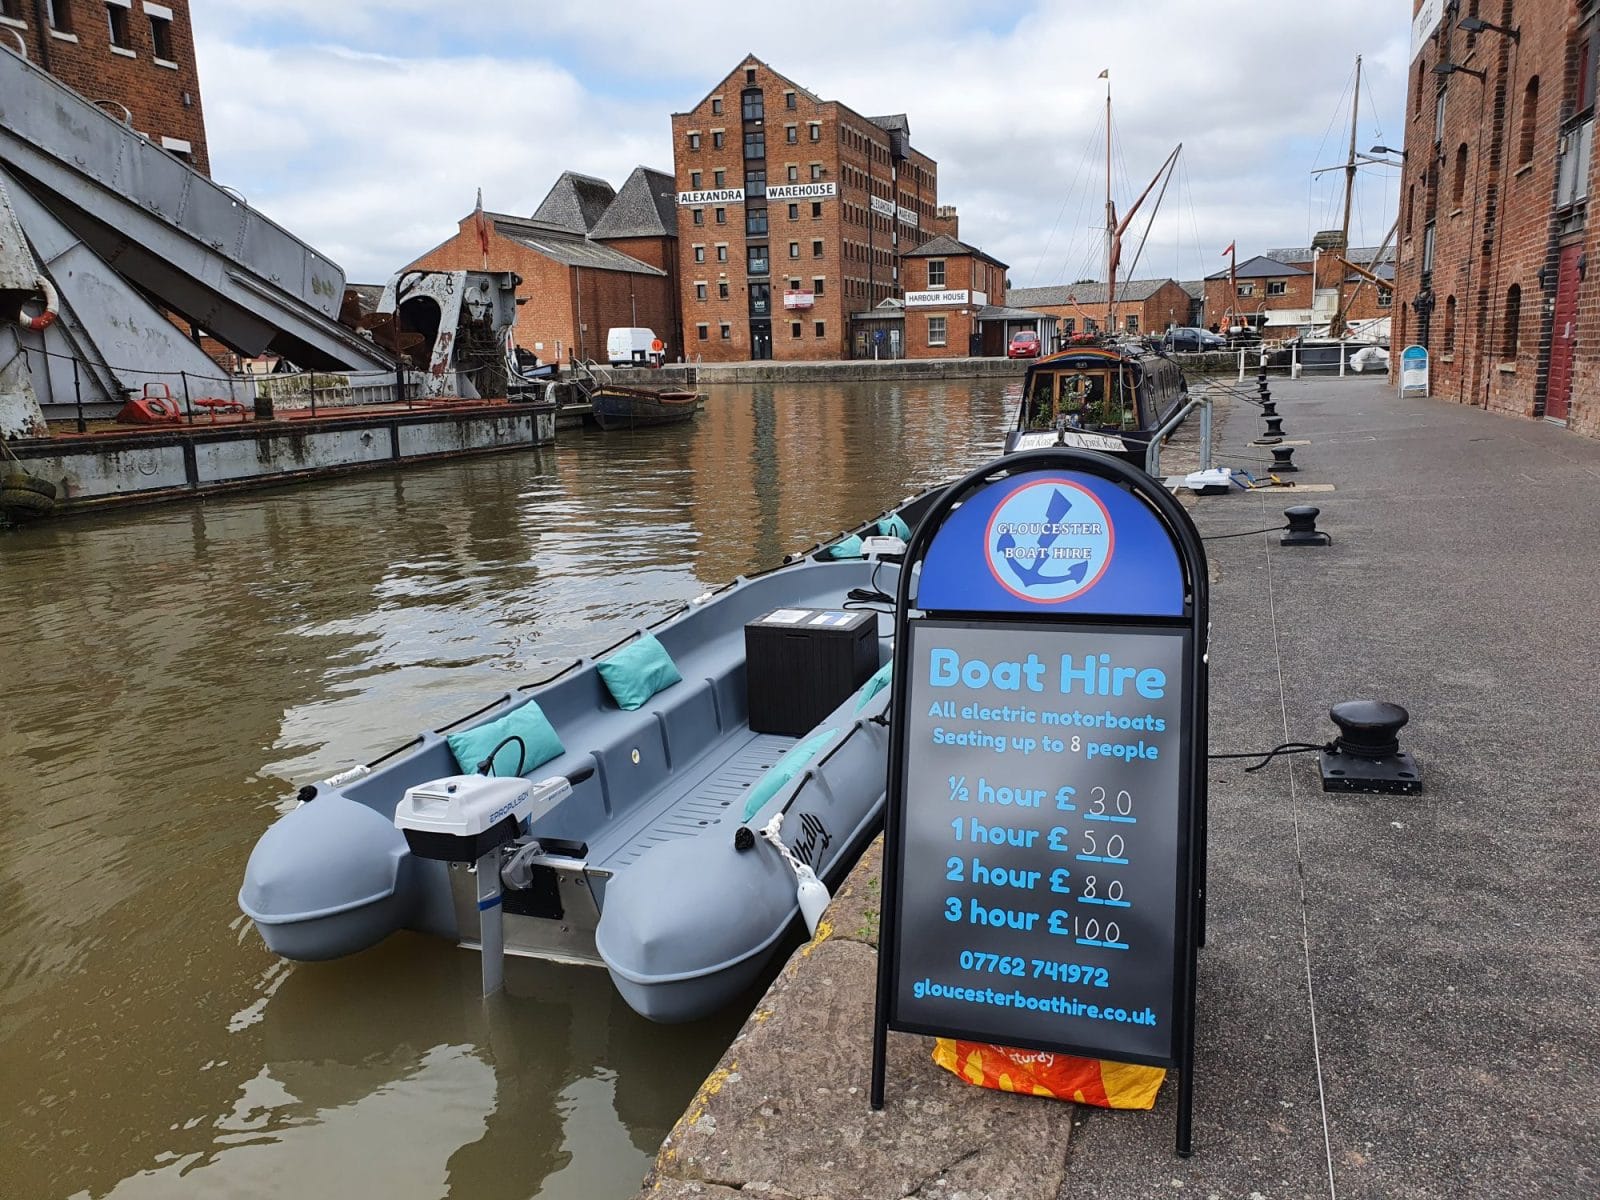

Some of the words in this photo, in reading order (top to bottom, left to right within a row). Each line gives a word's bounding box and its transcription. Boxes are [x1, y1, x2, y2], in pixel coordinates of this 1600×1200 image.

[681, 190, 743, 203] ALEXANDRA
[768, 184, 833, 197] WAREHOUSE
[909, 294, 940, 302] HARBOUR
[943, 293, 965, 301] HOUSE
[997, 523, 1102, 535] GLOUCESTER
[1004, 547, 1048, 560] BOAT
[1052, 547, 1092, 560] HIRE
[929, 648, 1046, 692] Boat
[1060, 653, 1167, 699] Hire
[928, 701, 957, 719] All
[961, 702, 1037, 724] electric
[1041, 710, 1166, 732] motorboats
[933, 727, 1007, 753] Seating
[1012, 737, 1037, 755] up
[1041, 736, 1064, 752] to
[1070, 735, 1081, 752] 8
[1086, 740, 1159, 762] people
[977, 777, 1048, 808] hour
[1055, 785, 1077, 811] £
[1089, 786, 1132, 816] 30
[951, 816, 963, 841] 1
[971, 817, 1039, 848] hour
[1047, 826, 1068, 851] £
[1082, 830, 1125, 858] 50
[946, 856, 964, 882] 2
[972, 858, 1041, 890] hour
[1049, 868, 1071, 894] £
[1083, 875, 1124, 901] 80
[944, 896, 962, 922] 3
[970, 898, 1039, 931] hour
[1047, 909, 1069, 935] £
[1075, 916, 1120, 943] 100
[959, 950, 1026, 977] 07762
[1031, 959, 1109, 988] 741972
[913, 978, 1157, 1026] gloucesterboathire.co.uk
